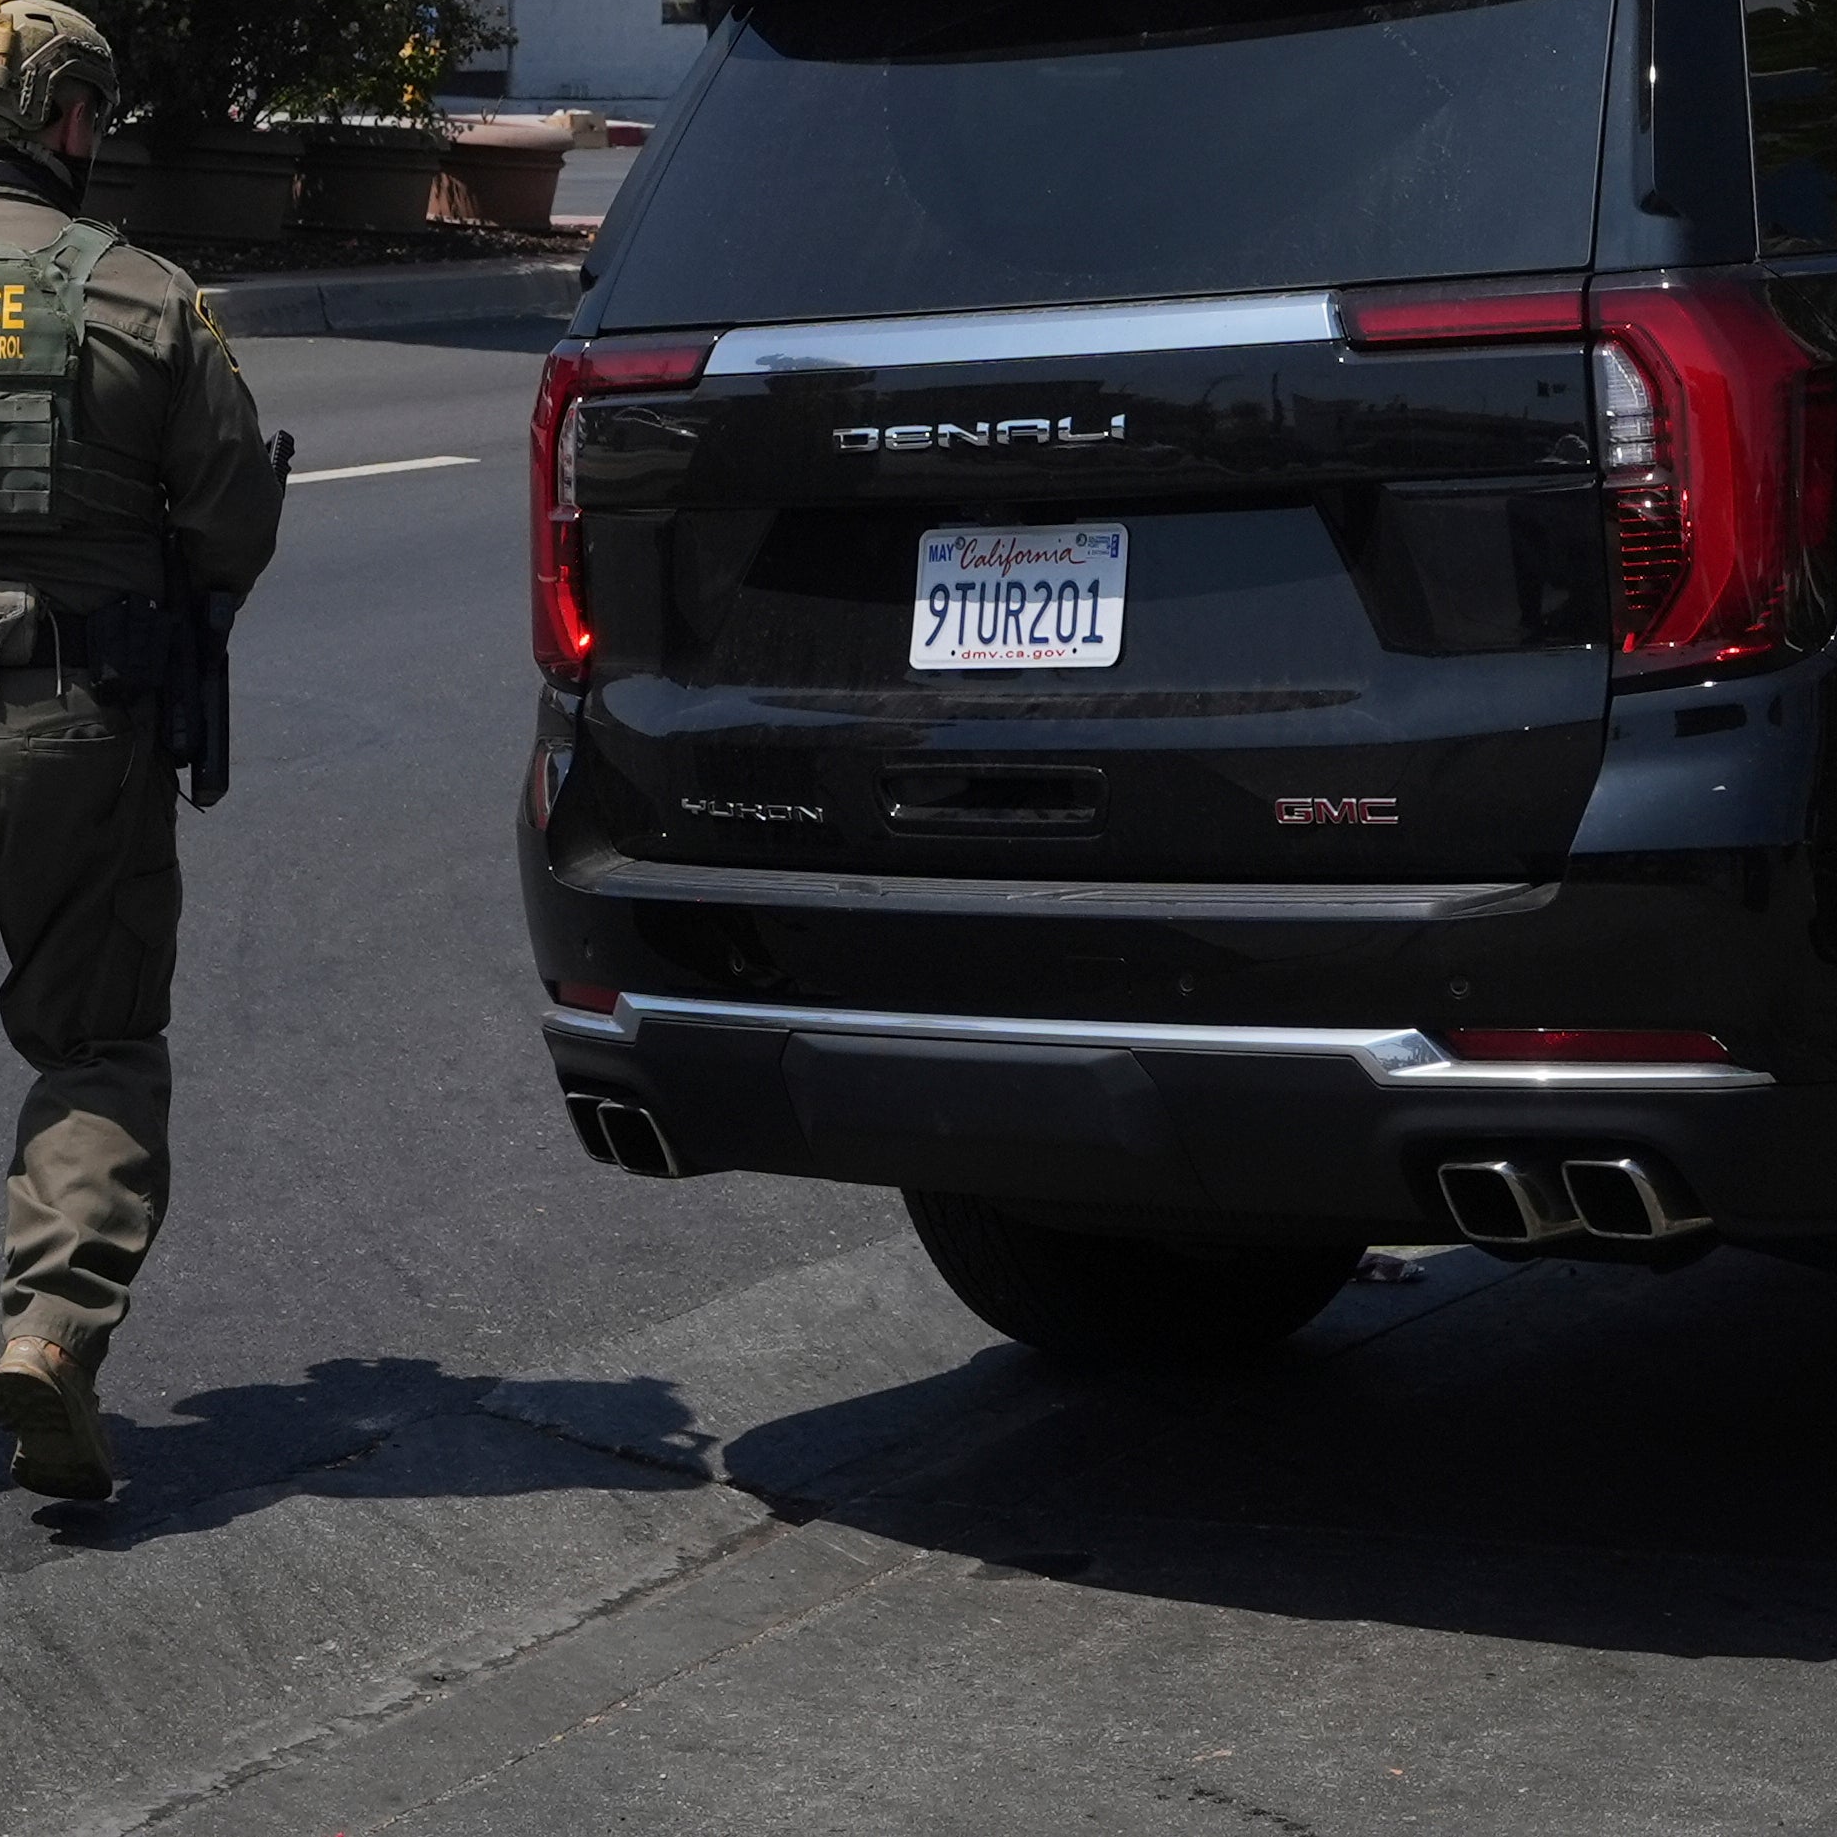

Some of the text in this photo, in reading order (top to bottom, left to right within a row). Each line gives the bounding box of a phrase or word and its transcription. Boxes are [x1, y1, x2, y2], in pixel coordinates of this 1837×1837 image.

[832, 413, 1126, 453] DENALI
[928, 544, 956, 564] MAY
[959, 537, 1087, 578] California
[924, 579, 1104, 648] 9TUR201
[961, 646, 1067, 662] dmv.ca.gov
[681, 797, 825, 824] YUKON
[1274, 796, 1400, 825] GMC
